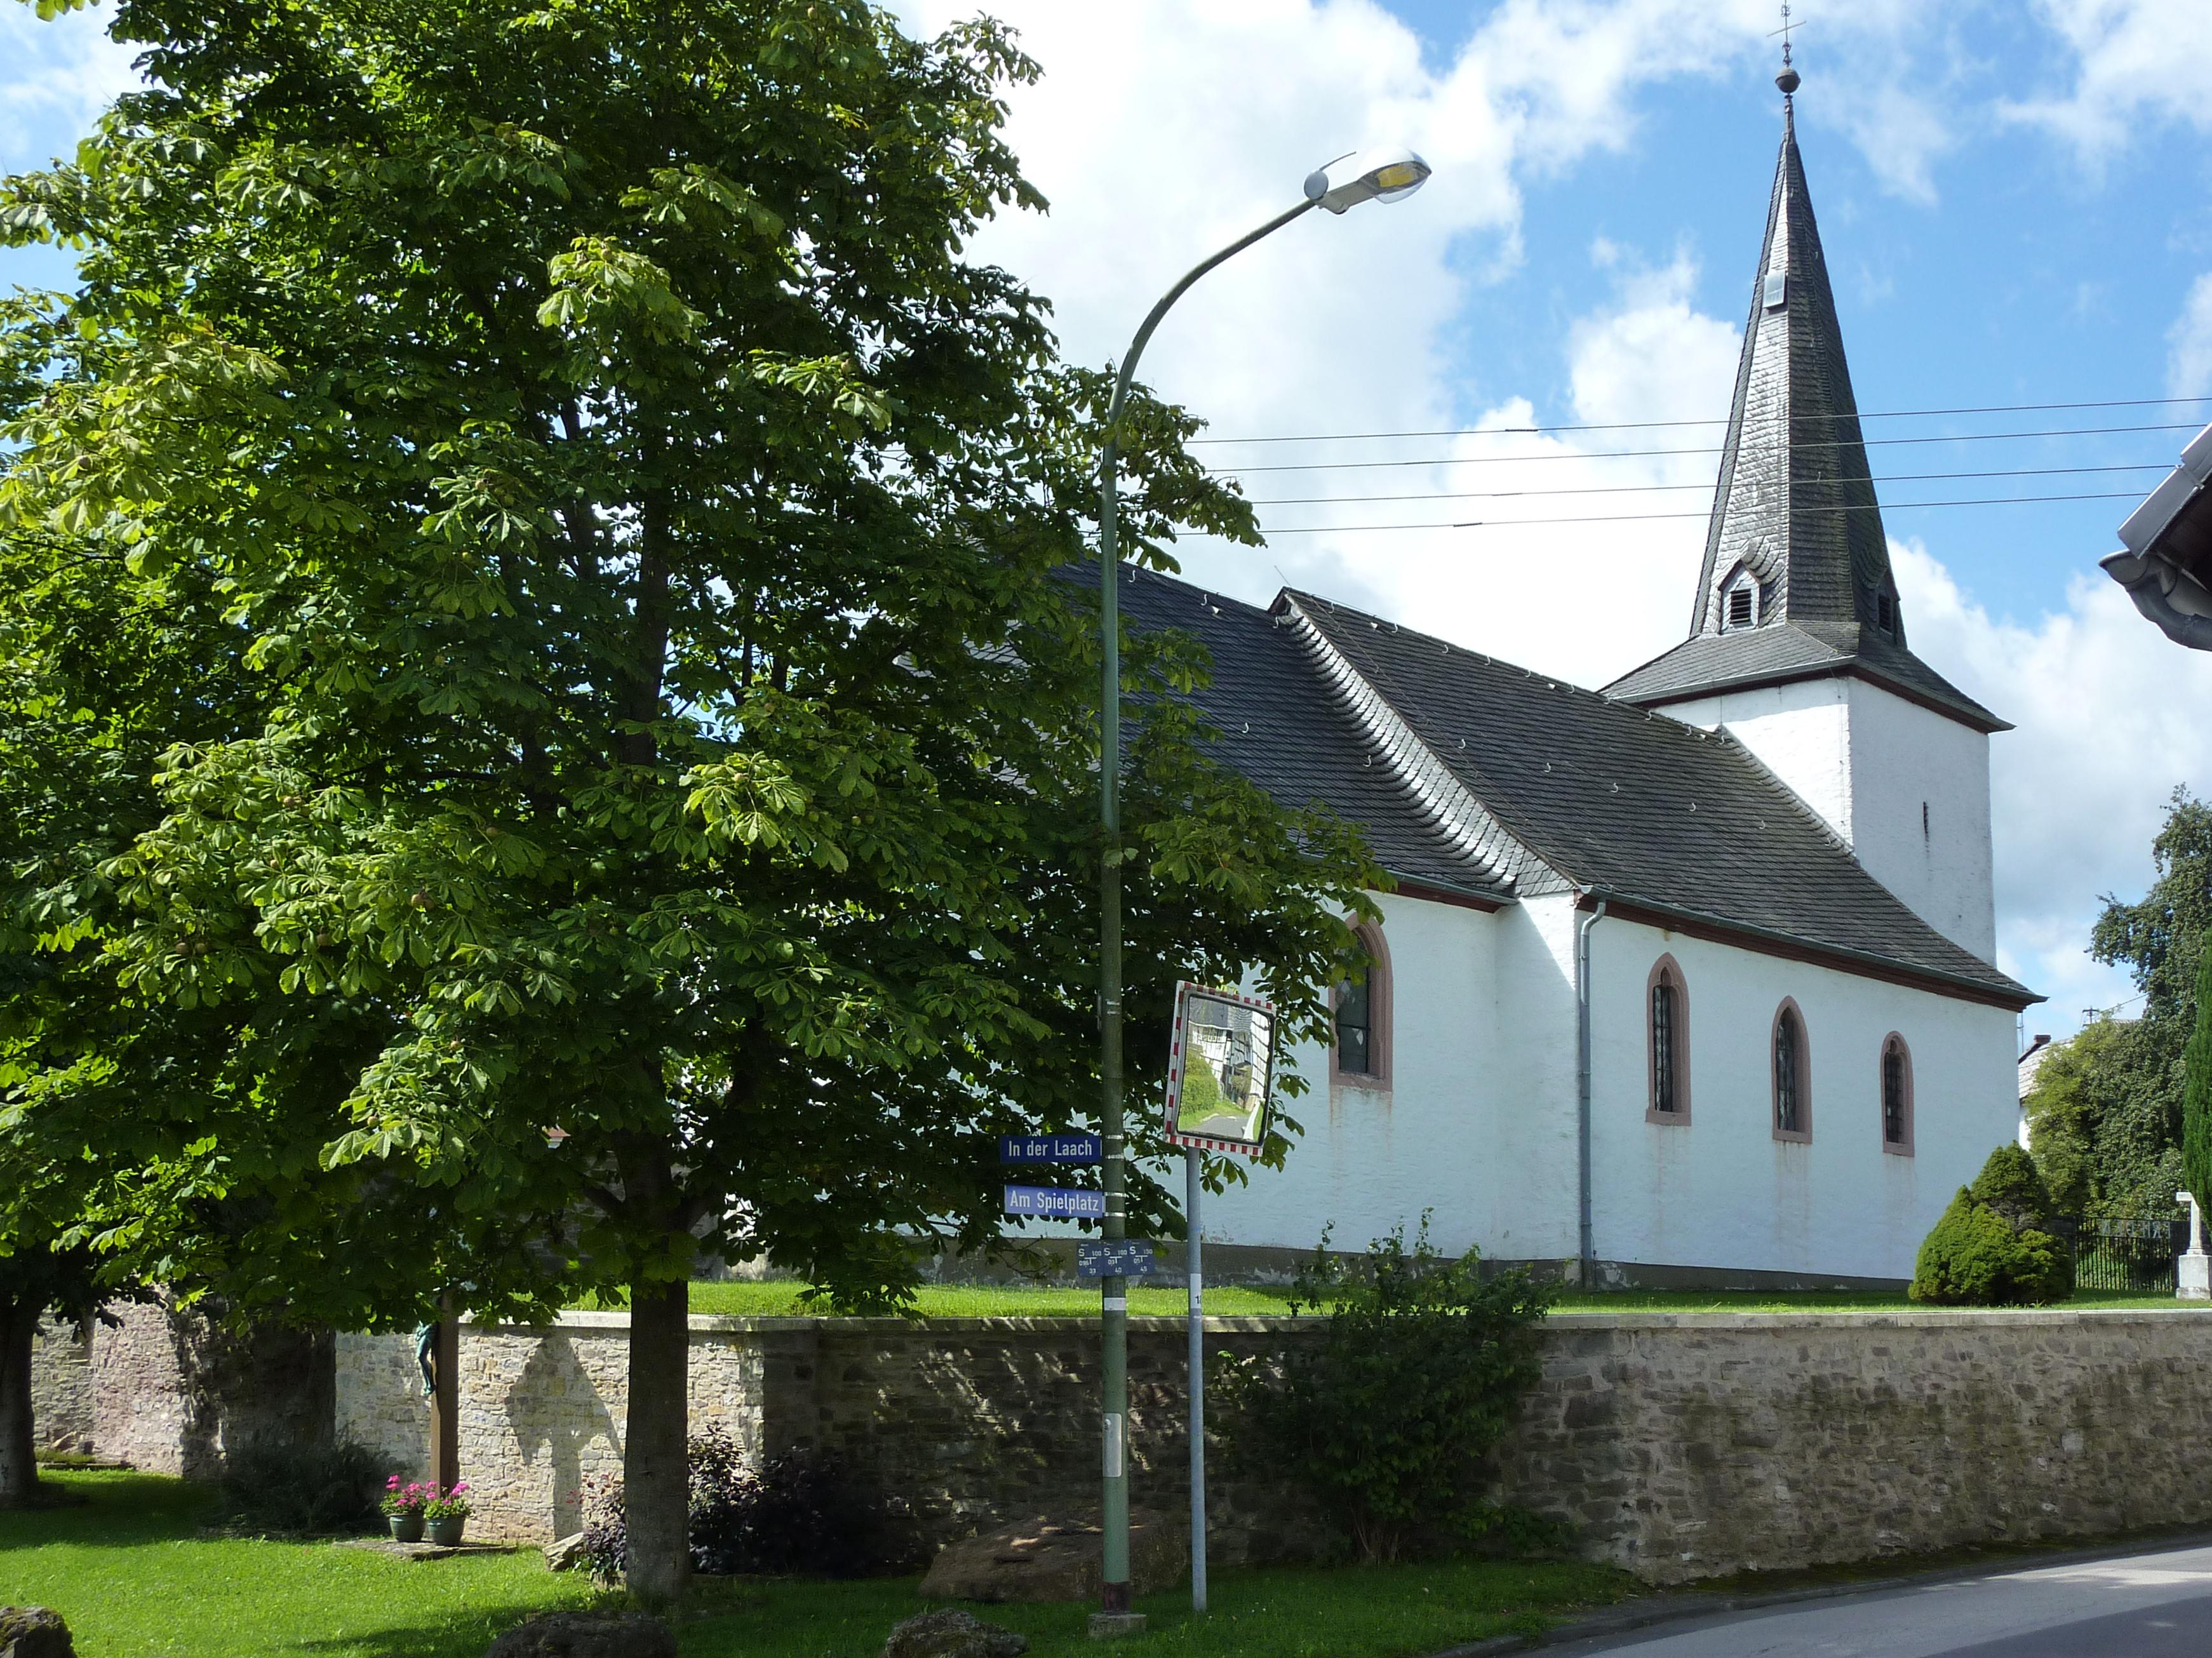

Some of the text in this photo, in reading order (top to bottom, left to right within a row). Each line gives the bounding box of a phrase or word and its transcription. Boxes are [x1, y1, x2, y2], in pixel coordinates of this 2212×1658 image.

[1009, 1140, 1092, 1156] In der Laach
[1010, 1190, 1099, 1214] Am Spielplatz
[1078, 1248, 1085, 1257] S
[1129, 1246, 1136, 1254] S
